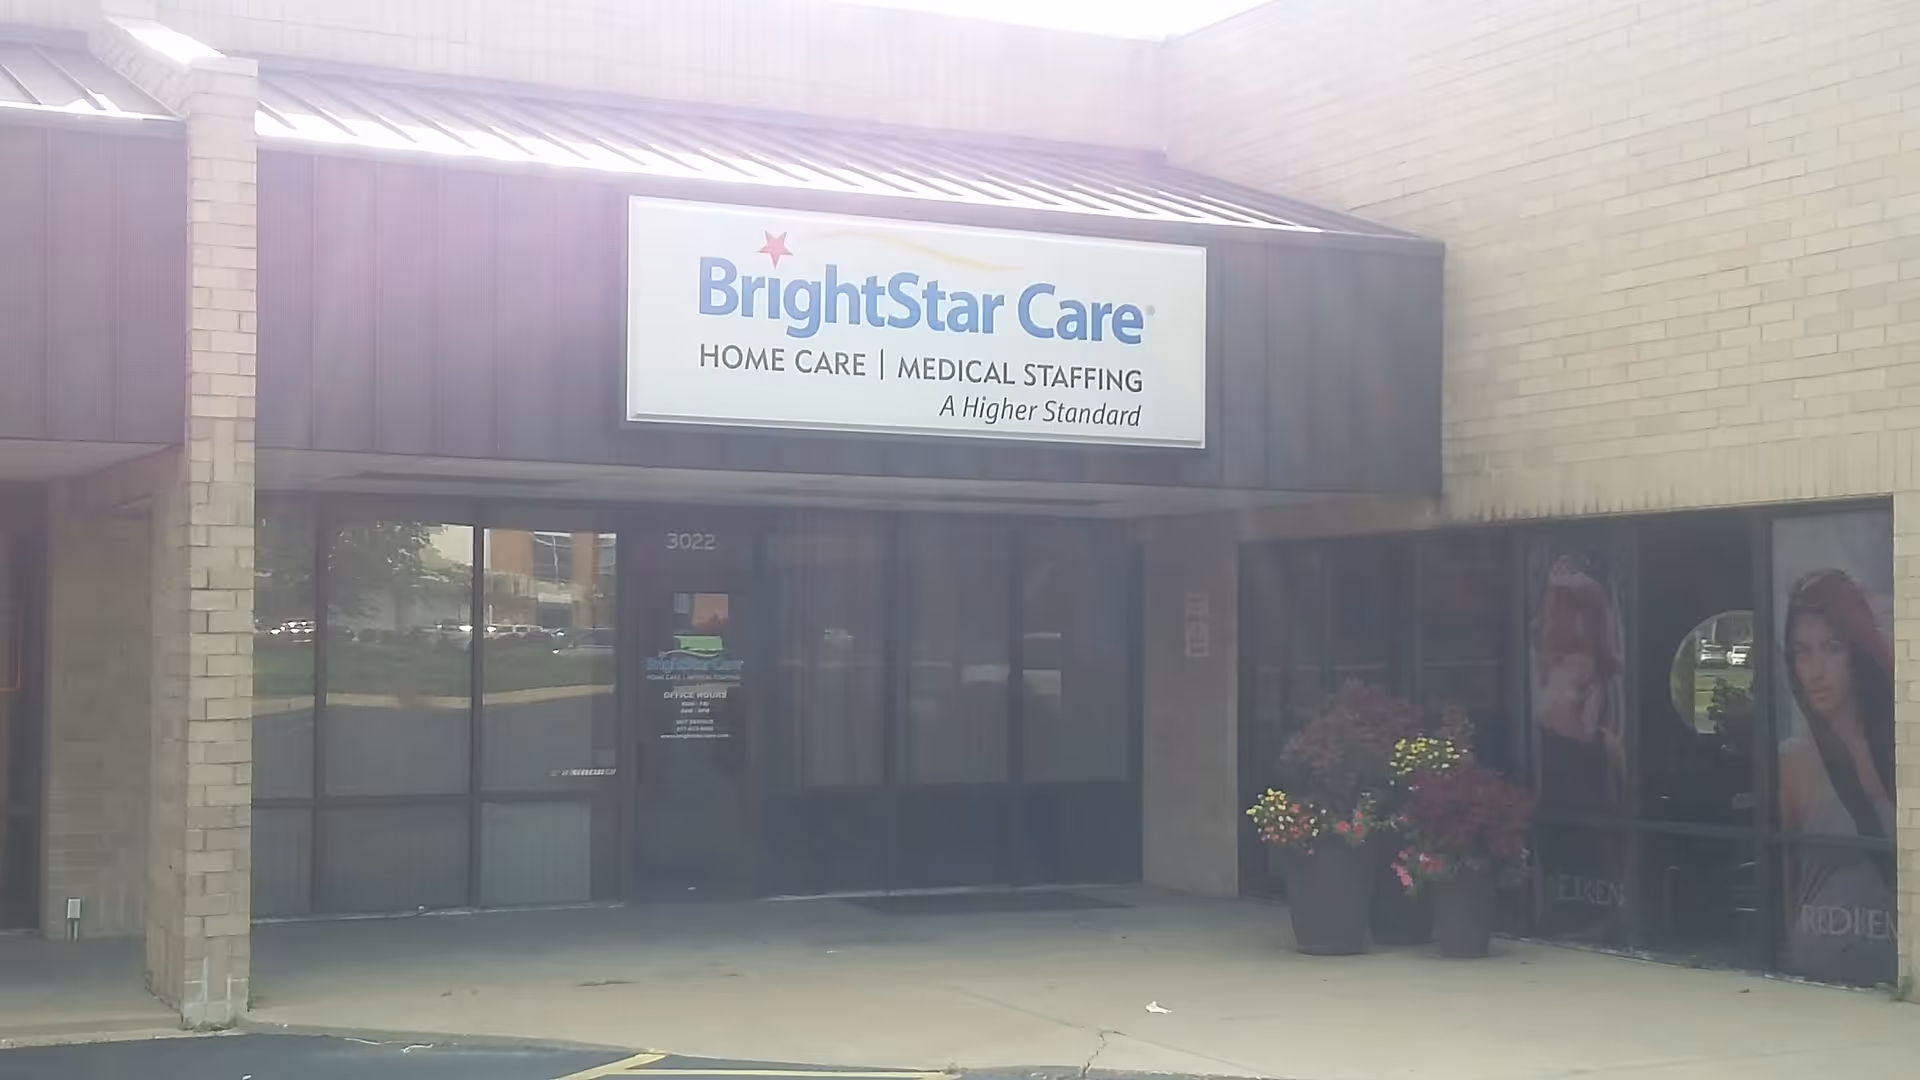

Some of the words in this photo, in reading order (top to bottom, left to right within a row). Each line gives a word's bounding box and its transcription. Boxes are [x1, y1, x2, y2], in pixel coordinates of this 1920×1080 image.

[699, 255, 1005, 338] BrightStar
[1017, 282, 1144, 345] Care
[700, 343, 785, 371] HOME
[795, 349, 866, 376] CARE
[898, 356, 1015, 385] MEDICAL
[1024, 363, 1143, 393] STAFFING
[939, 395, 955, 417] A
[963, 396, 1038, 424] Higher
[1042, 400, 1142, 427] Standard
[665, 532, 715, 550] 3022
